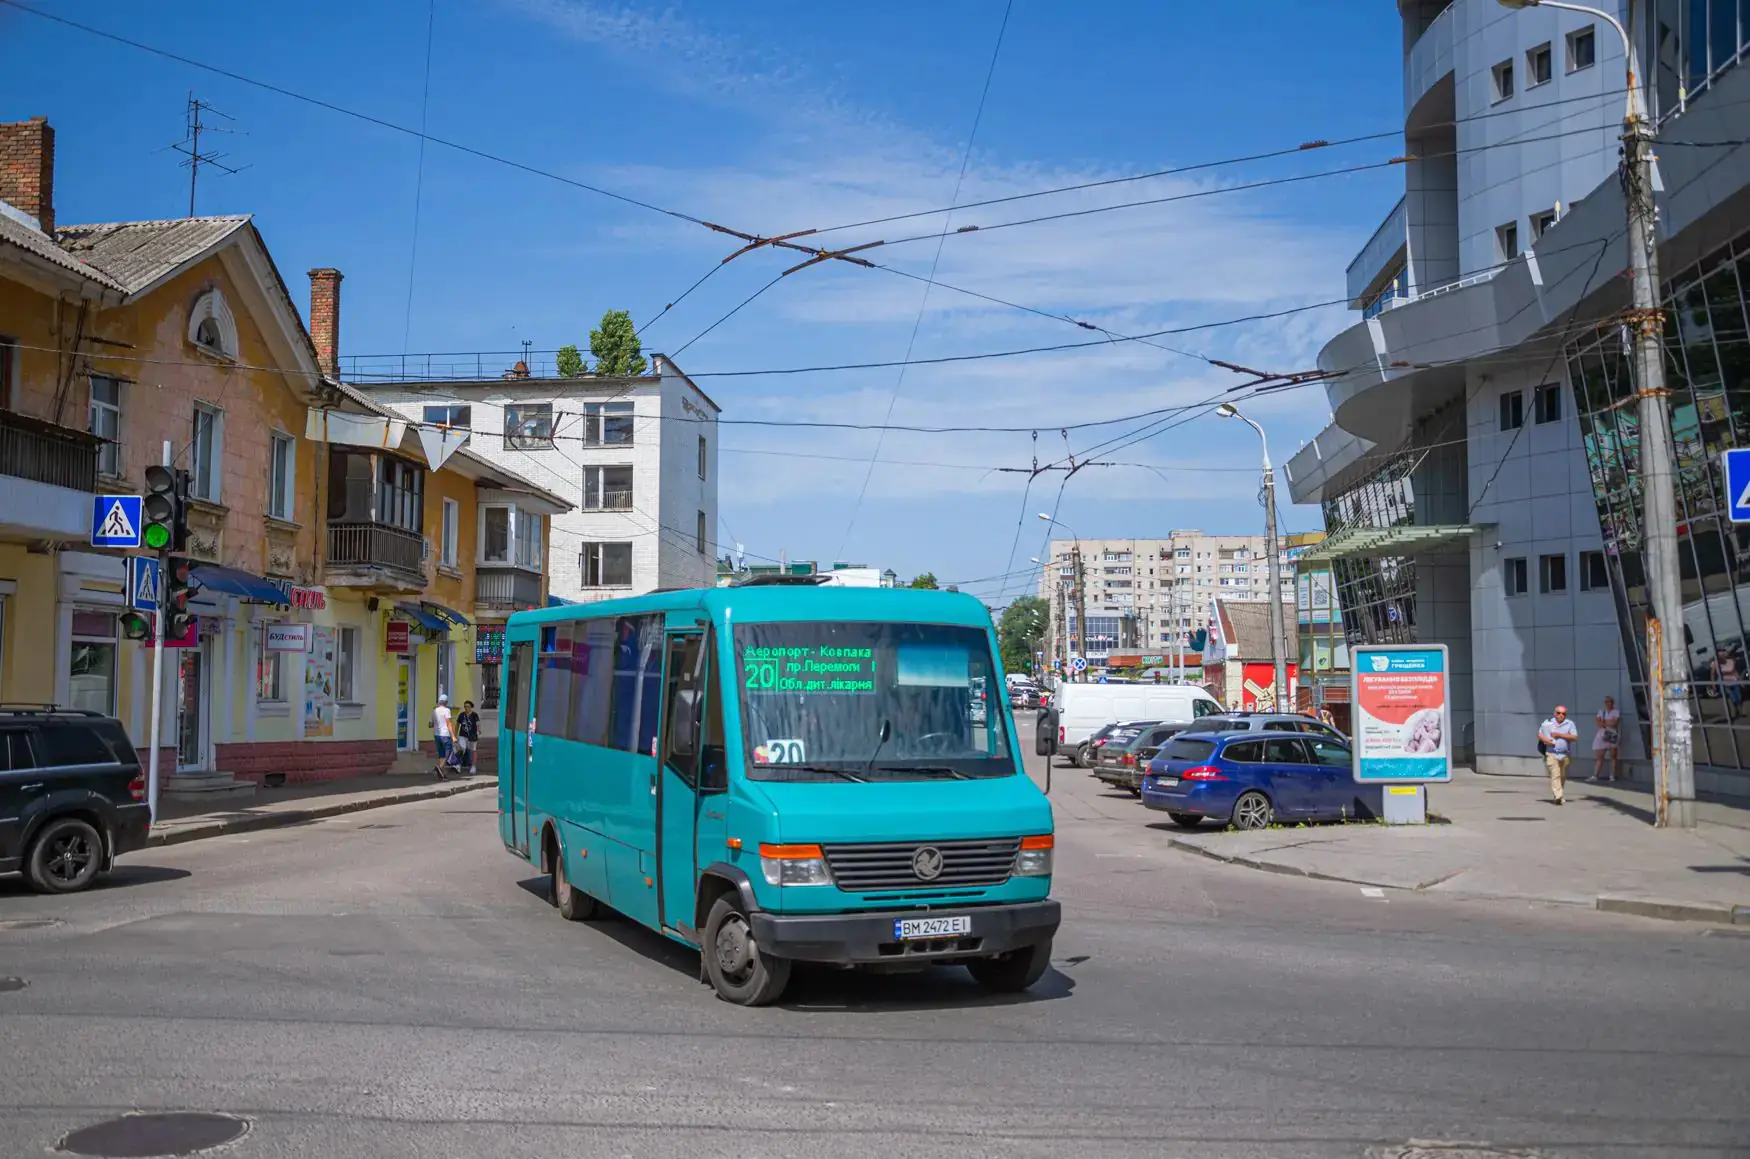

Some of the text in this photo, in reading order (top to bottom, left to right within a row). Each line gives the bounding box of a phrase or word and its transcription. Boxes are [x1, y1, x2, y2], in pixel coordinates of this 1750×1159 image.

[744, 645, 809, 659] Аеропорт
[820, 645, 872, 658] Ковпака
[744, 663, 774, 688] 20
[770, 742, 803, 763] 20
[903, 922, 920, 935] BM
[923, 920, 949, 934] 2472
